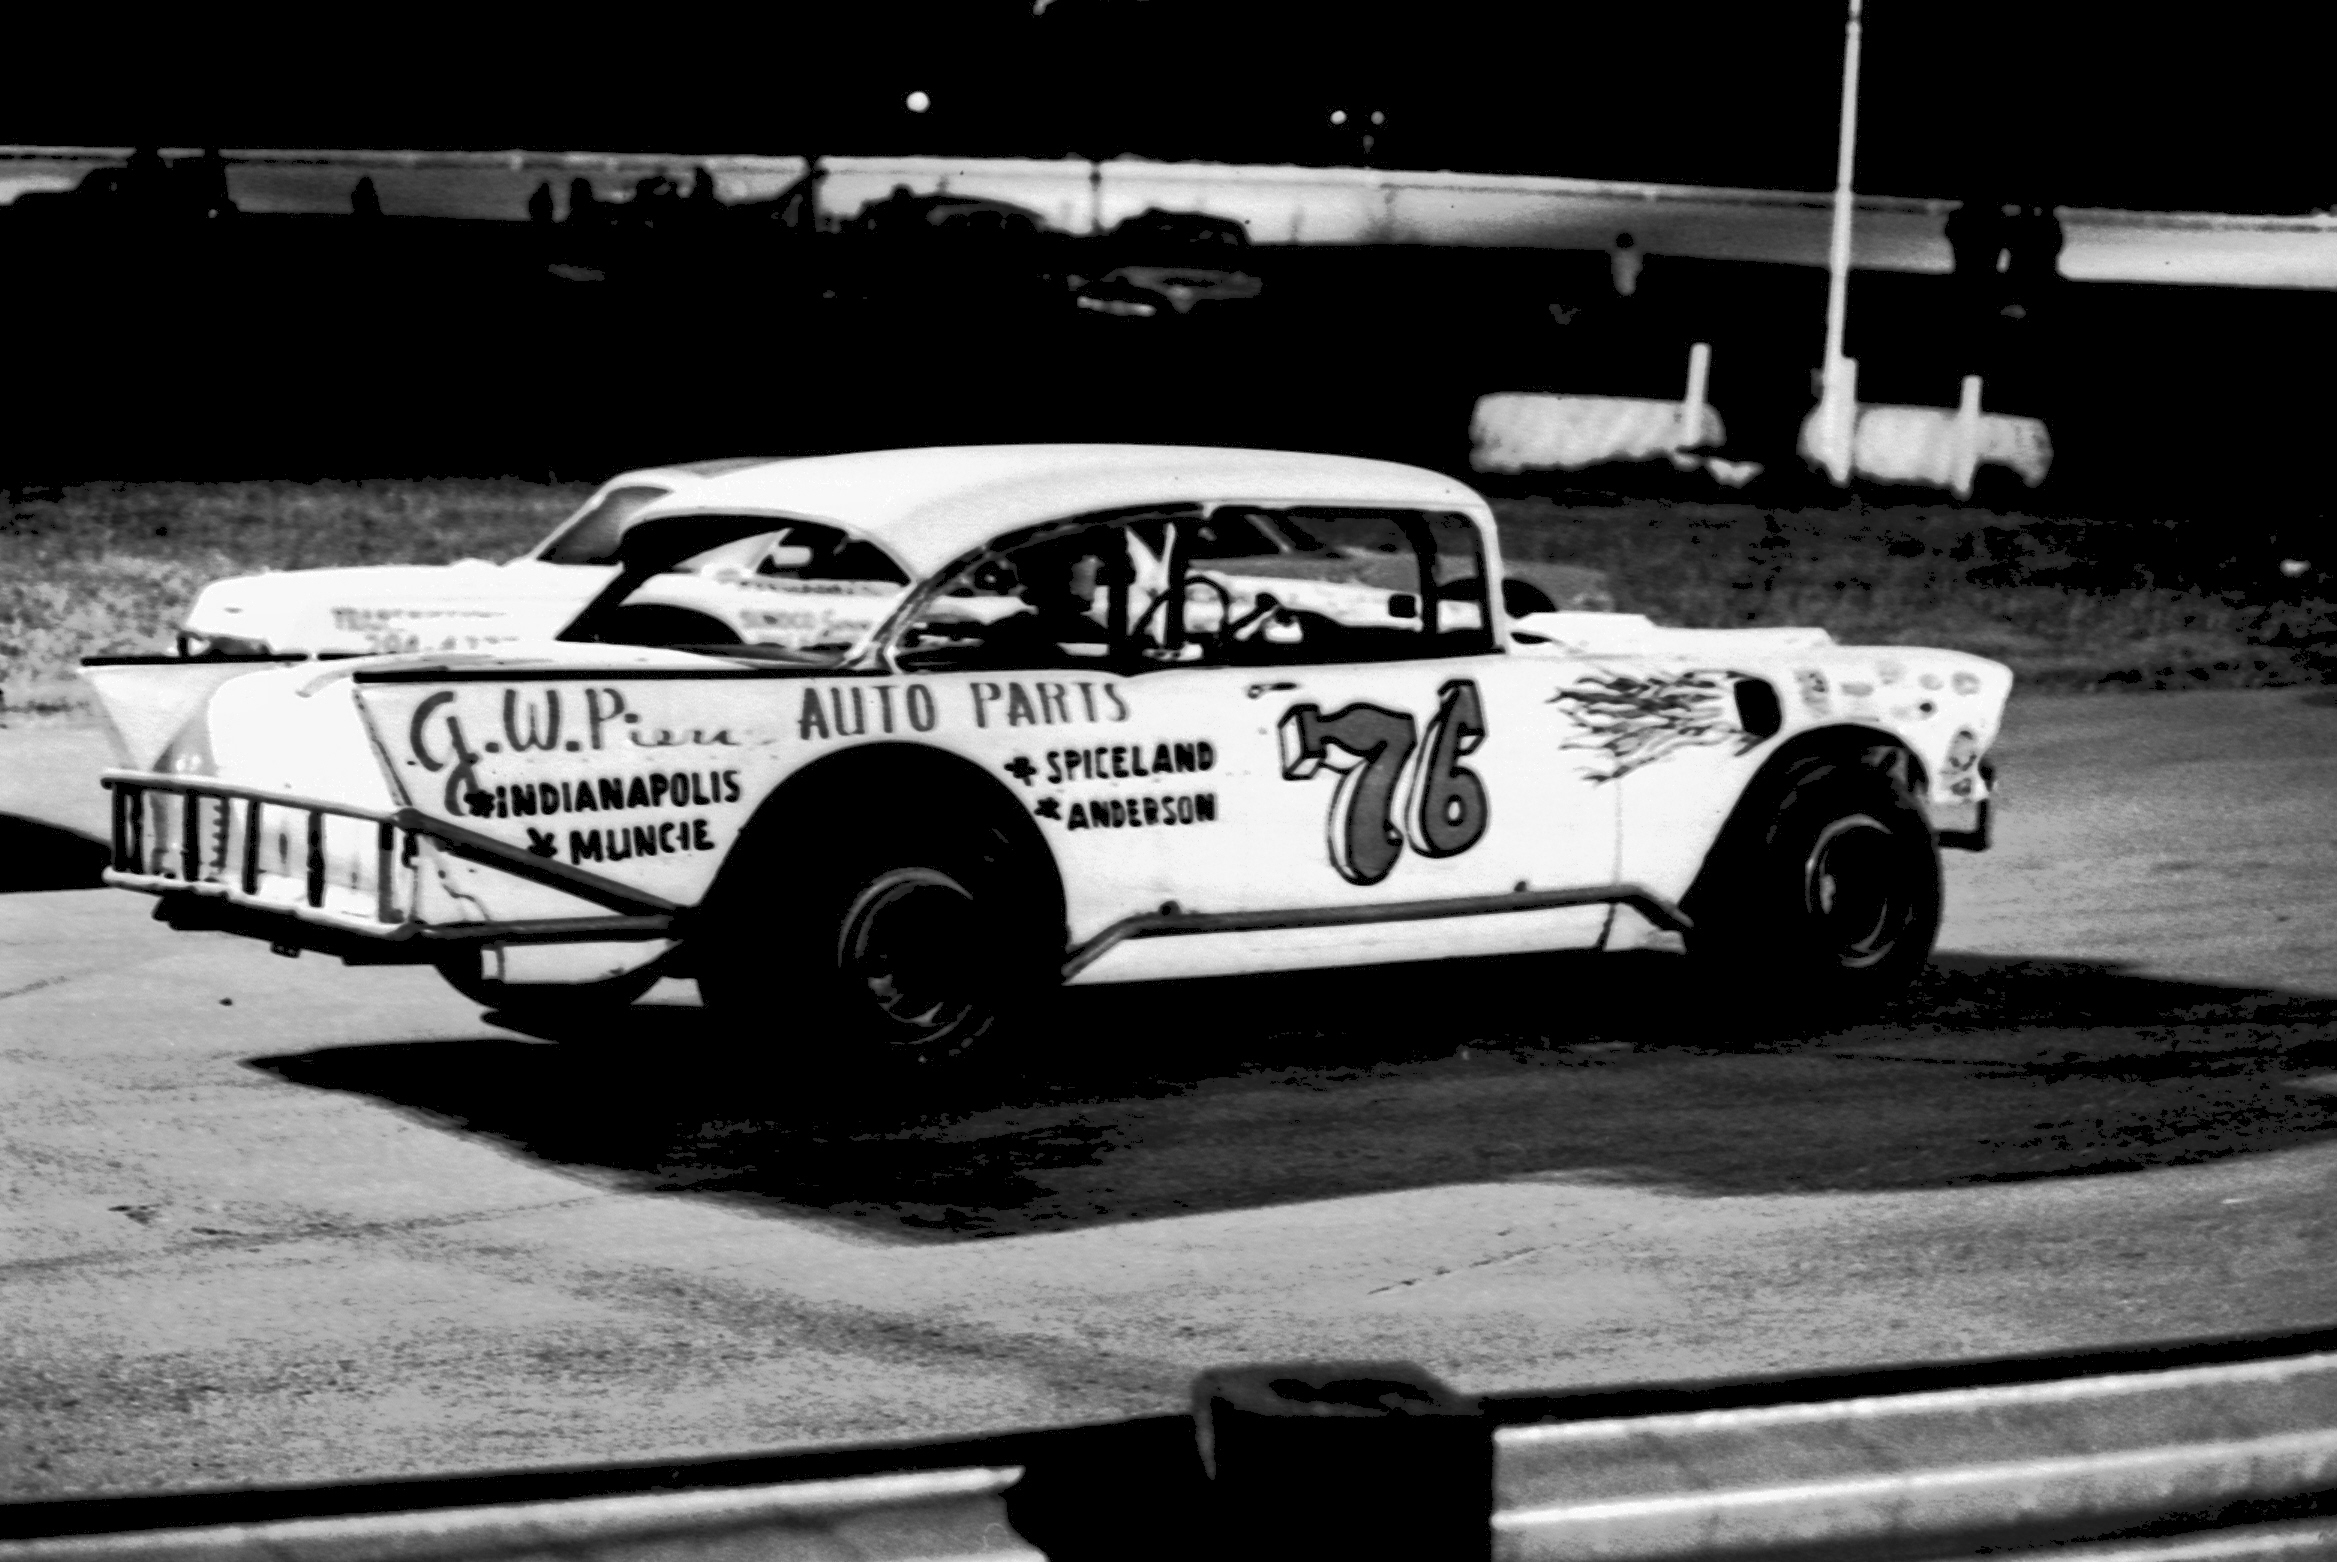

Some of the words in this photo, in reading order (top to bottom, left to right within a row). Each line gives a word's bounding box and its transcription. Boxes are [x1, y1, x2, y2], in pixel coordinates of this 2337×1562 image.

[798, 684, 937, 740] AUTO
[970, 681, 1130, 728] PARTS
[1045, 740, 1217, 784] SPICELAND
[1277, 678, 1490, 886] 76
[495, 770, 741, 819] INDIANAPOLIS
[1066, 792, 1217, 832] ANDERSON
[570, 819, 716, 866] MUNCIE
